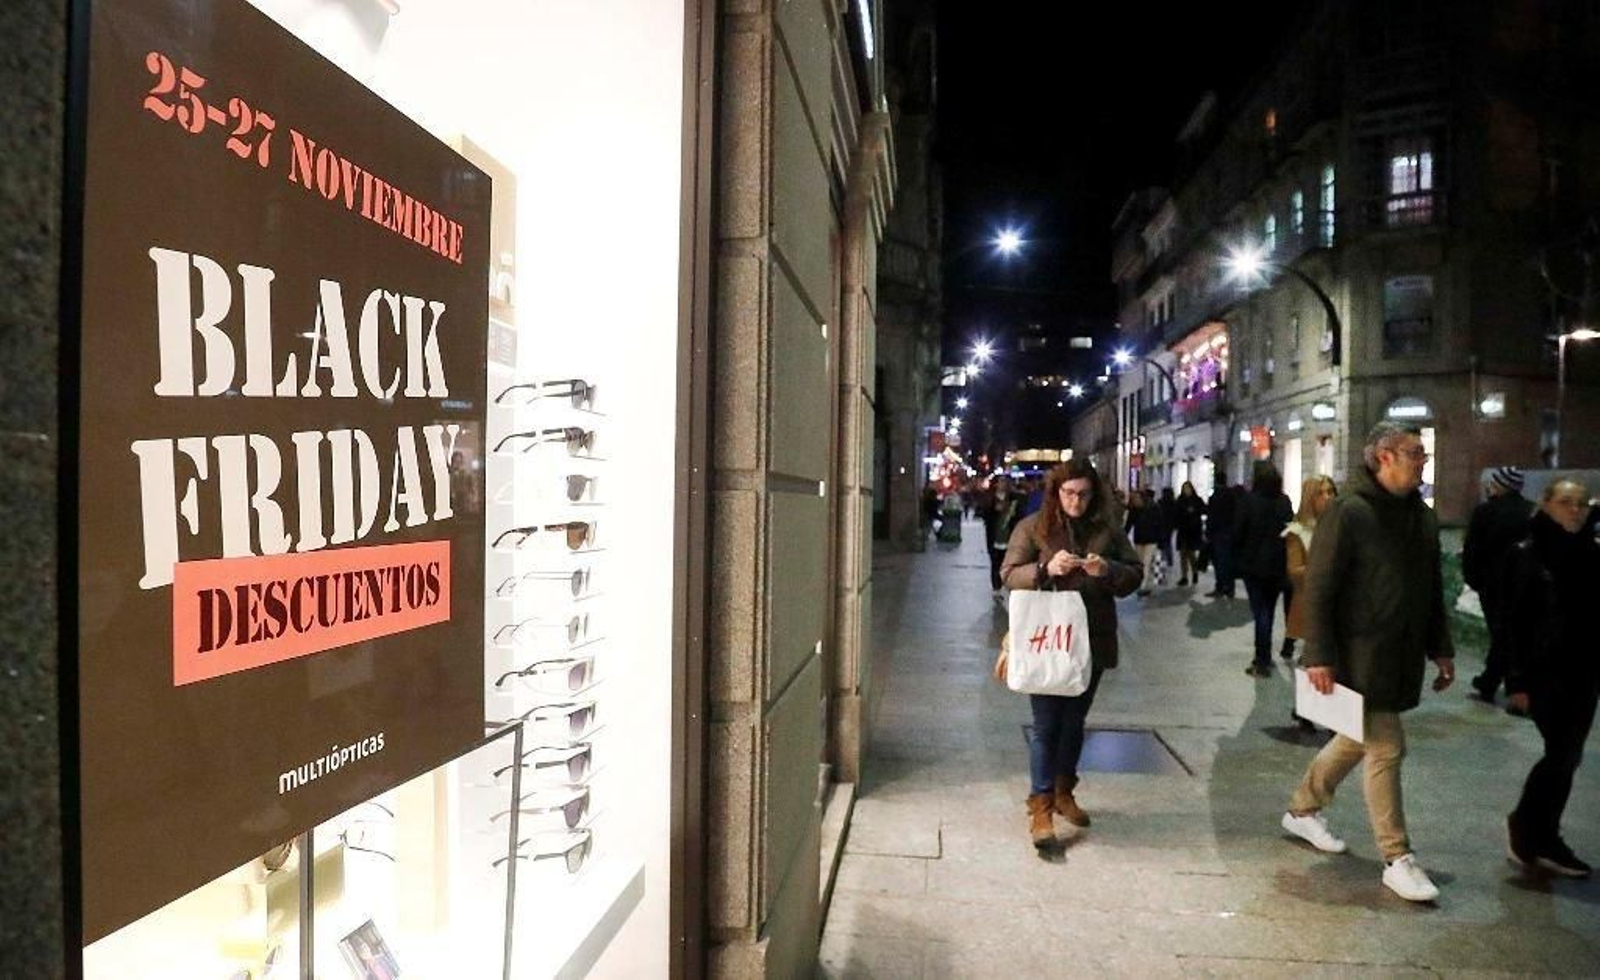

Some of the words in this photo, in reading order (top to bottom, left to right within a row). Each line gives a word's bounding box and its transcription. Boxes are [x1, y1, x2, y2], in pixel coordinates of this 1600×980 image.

[144, 52, 275, 168] 25-27
[288, 129, 463, 264] NOVIEMBRE
[149, 247, 448, 399] BLACK
[131, 425, 459, 590] FRIDAY
[197, 561, 440, 653] DESCUENTOS
